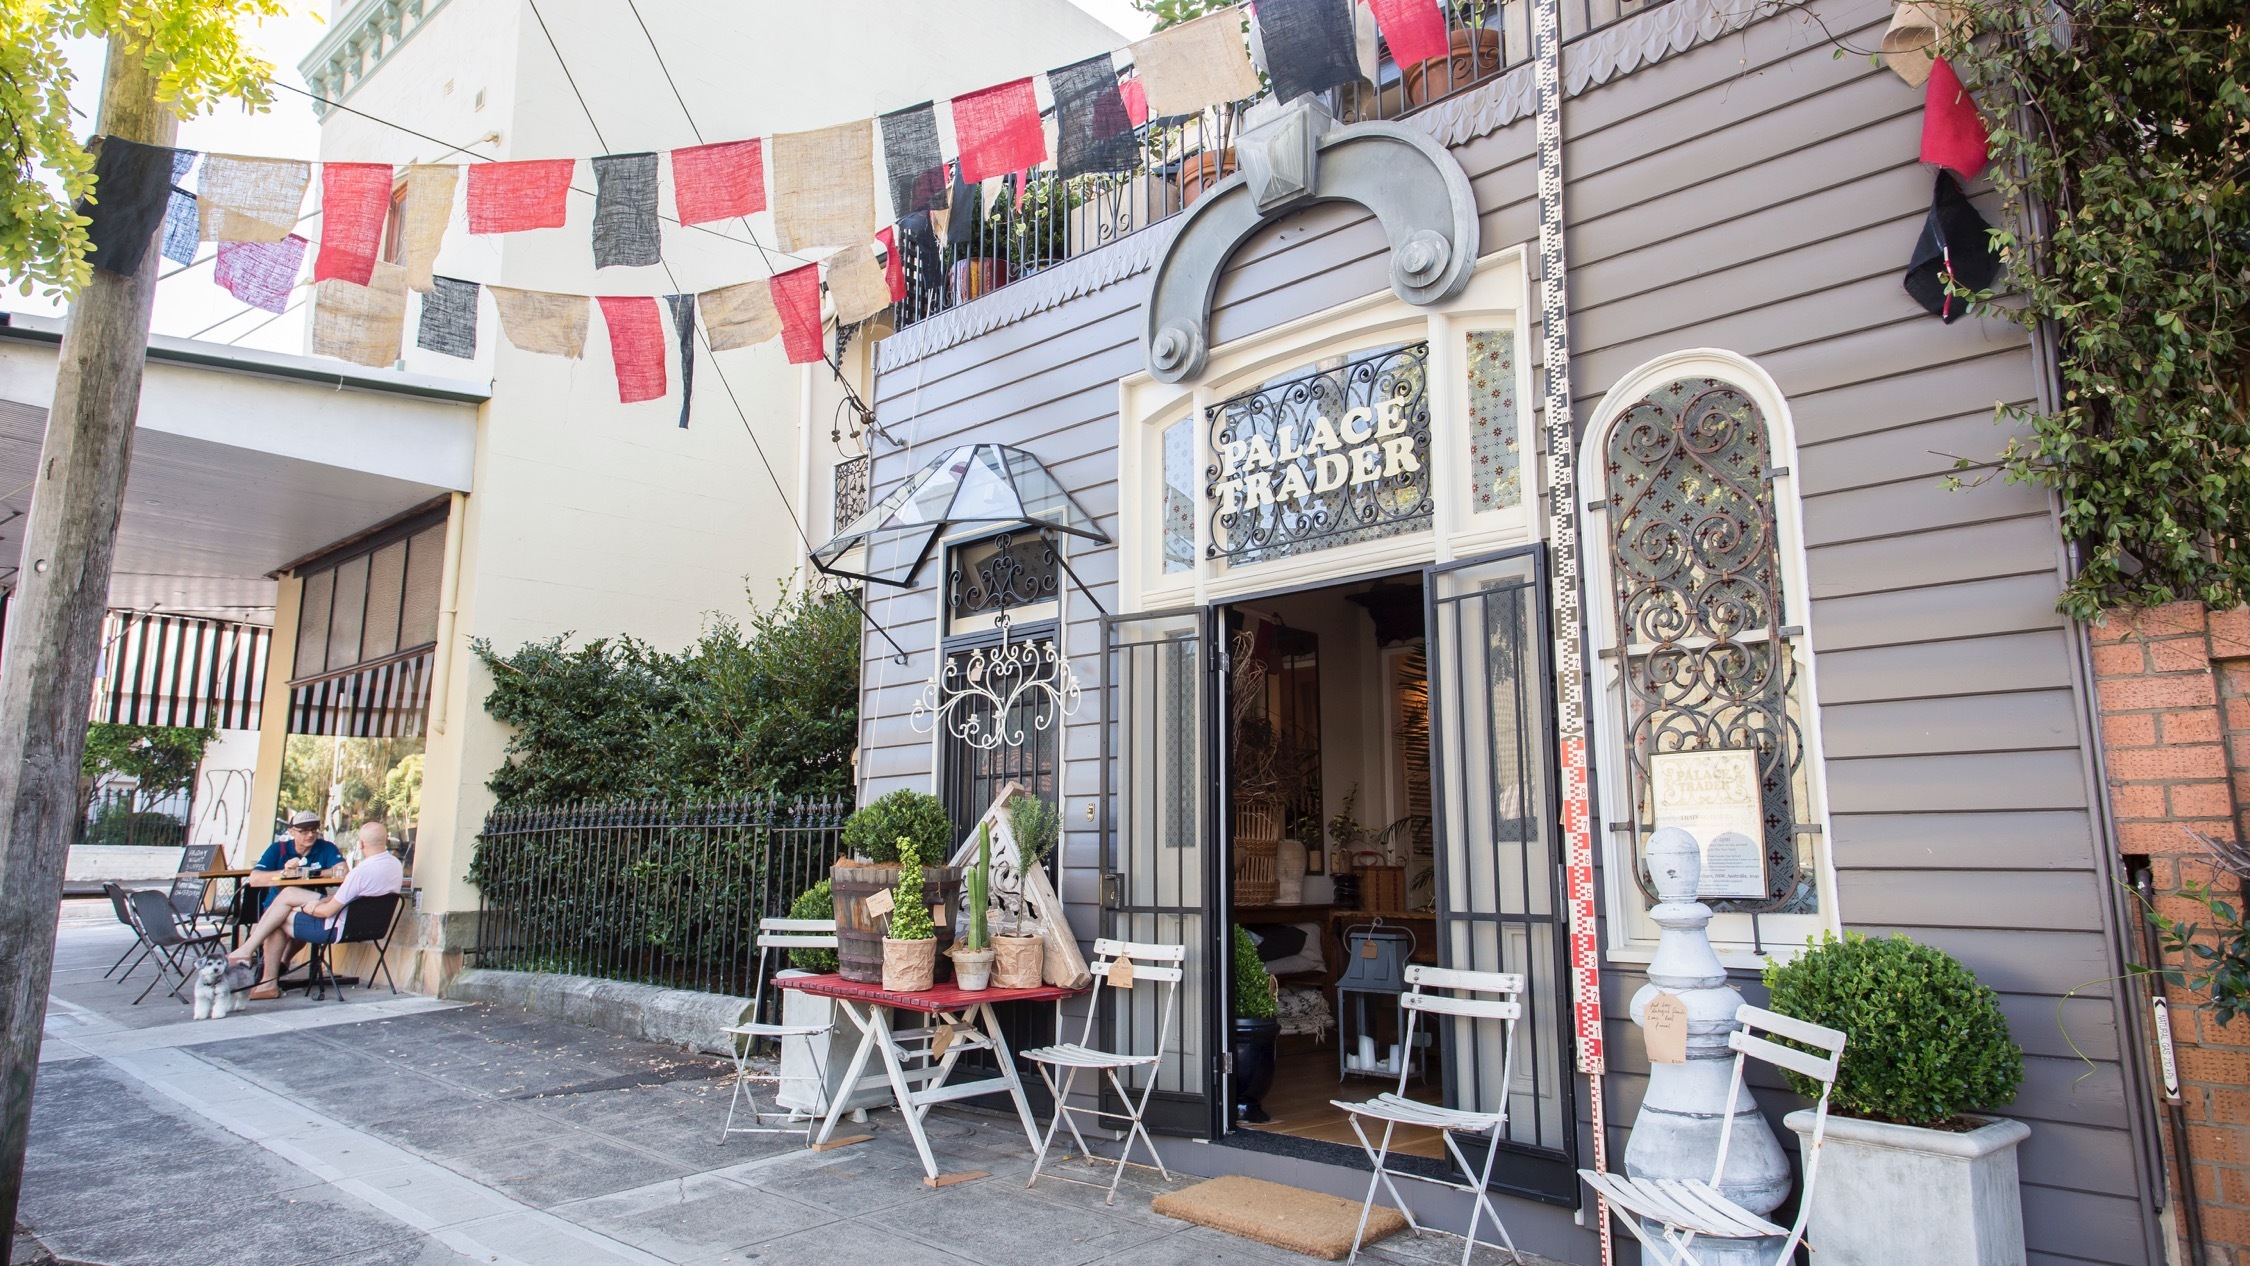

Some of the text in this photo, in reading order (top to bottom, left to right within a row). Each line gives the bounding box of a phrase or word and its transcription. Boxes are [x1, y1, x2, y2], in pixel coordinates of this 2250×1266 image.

[1221, 396, 1408, 477] PALACE
[1215, 436, 1420, 515] TRADER
[1566, 472, 1570, 482] 8
[1568, 533, 1574, 542] 6
[1570, 564, 1575, 574] 5
[1573, 626, 1578, 636] 3
[1574, 658, 1580, 668] 2
[1580, 754, 1584, 766] 9
[1676, 769, 1729, 781] PALACE
[1678, 781, 1730, 792] TRADER
[1582, 788, 1586, 798] 8
[1583, 820, 1588, 832] 7
[1584, 854, 1590, 865] 6
[1586, 888, 1592, 898] 5
[1589, 922, 1594, 932] 4
[1591, 956, 1596, 968] 3
[1593, 992, 1598, 1002] 2
[2158, 1014, 2174, 1080] NATURAL GAS 210 kPa
